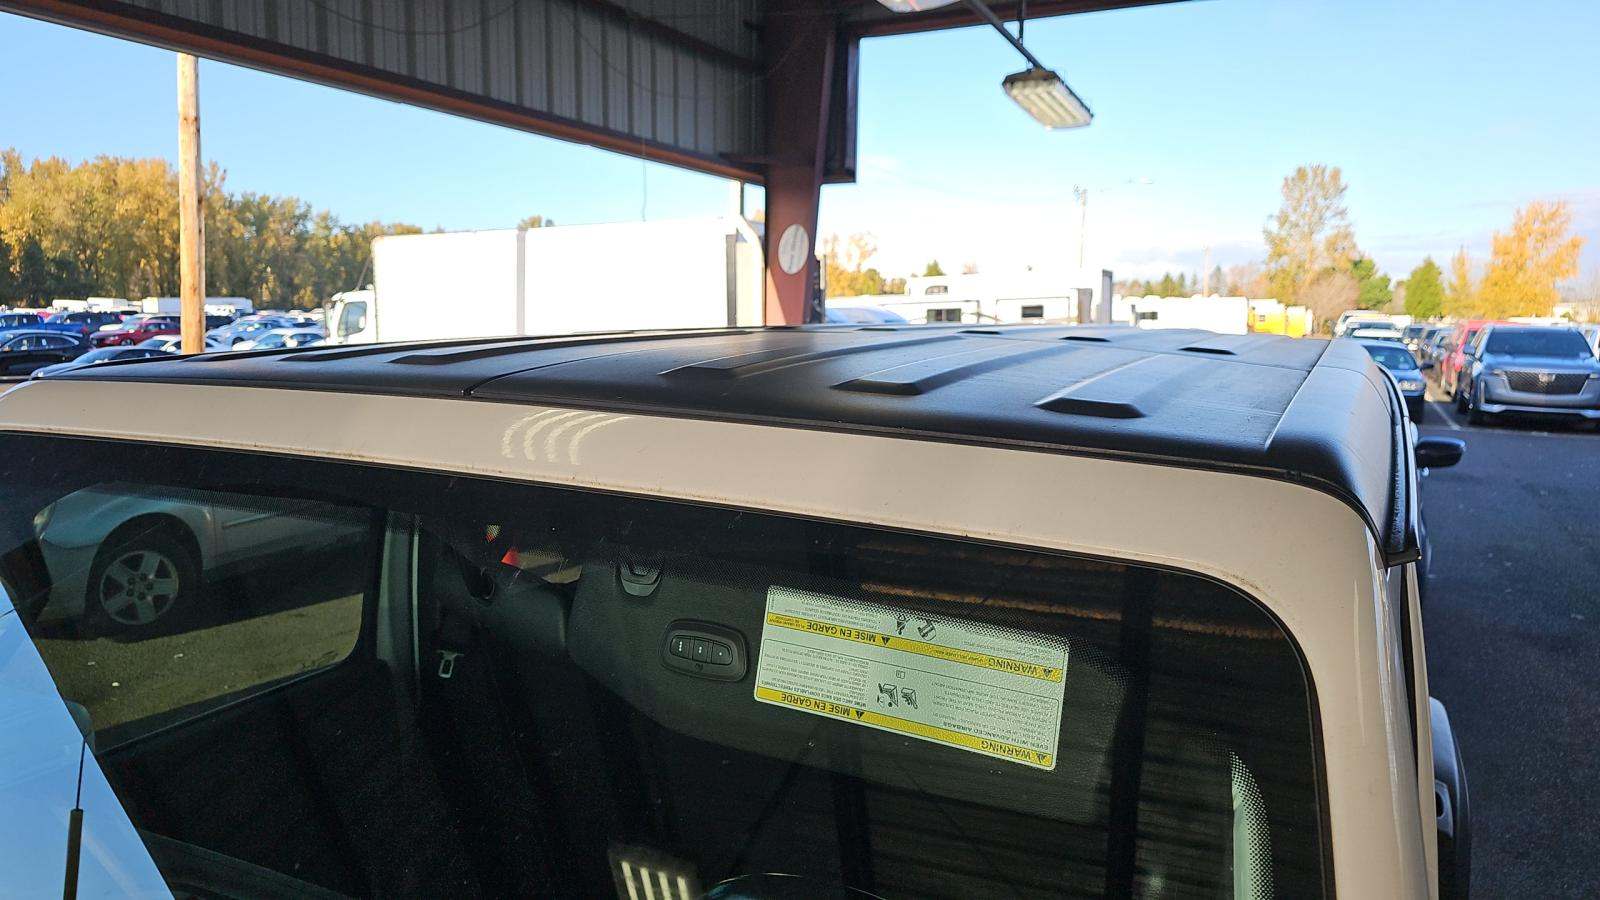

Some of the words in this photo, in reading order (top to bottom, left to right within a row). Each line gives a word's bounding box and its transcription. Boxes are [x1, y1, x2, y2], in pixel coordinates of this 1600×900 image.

[806, 621, 838, 636] GARDE
[839, 627, 853, 638] EN
[854, 630, 877, 643] MISE
[987, 656, 1037, 676] WARNING
[780, 692, 813, 708] GARDE
[812, 700, 827, 712] EN
[828, 703, 851, 717] MISE
[973, 727, 1011, 742] ADVANCED
[980, 739, 1032, 761] WARNING
